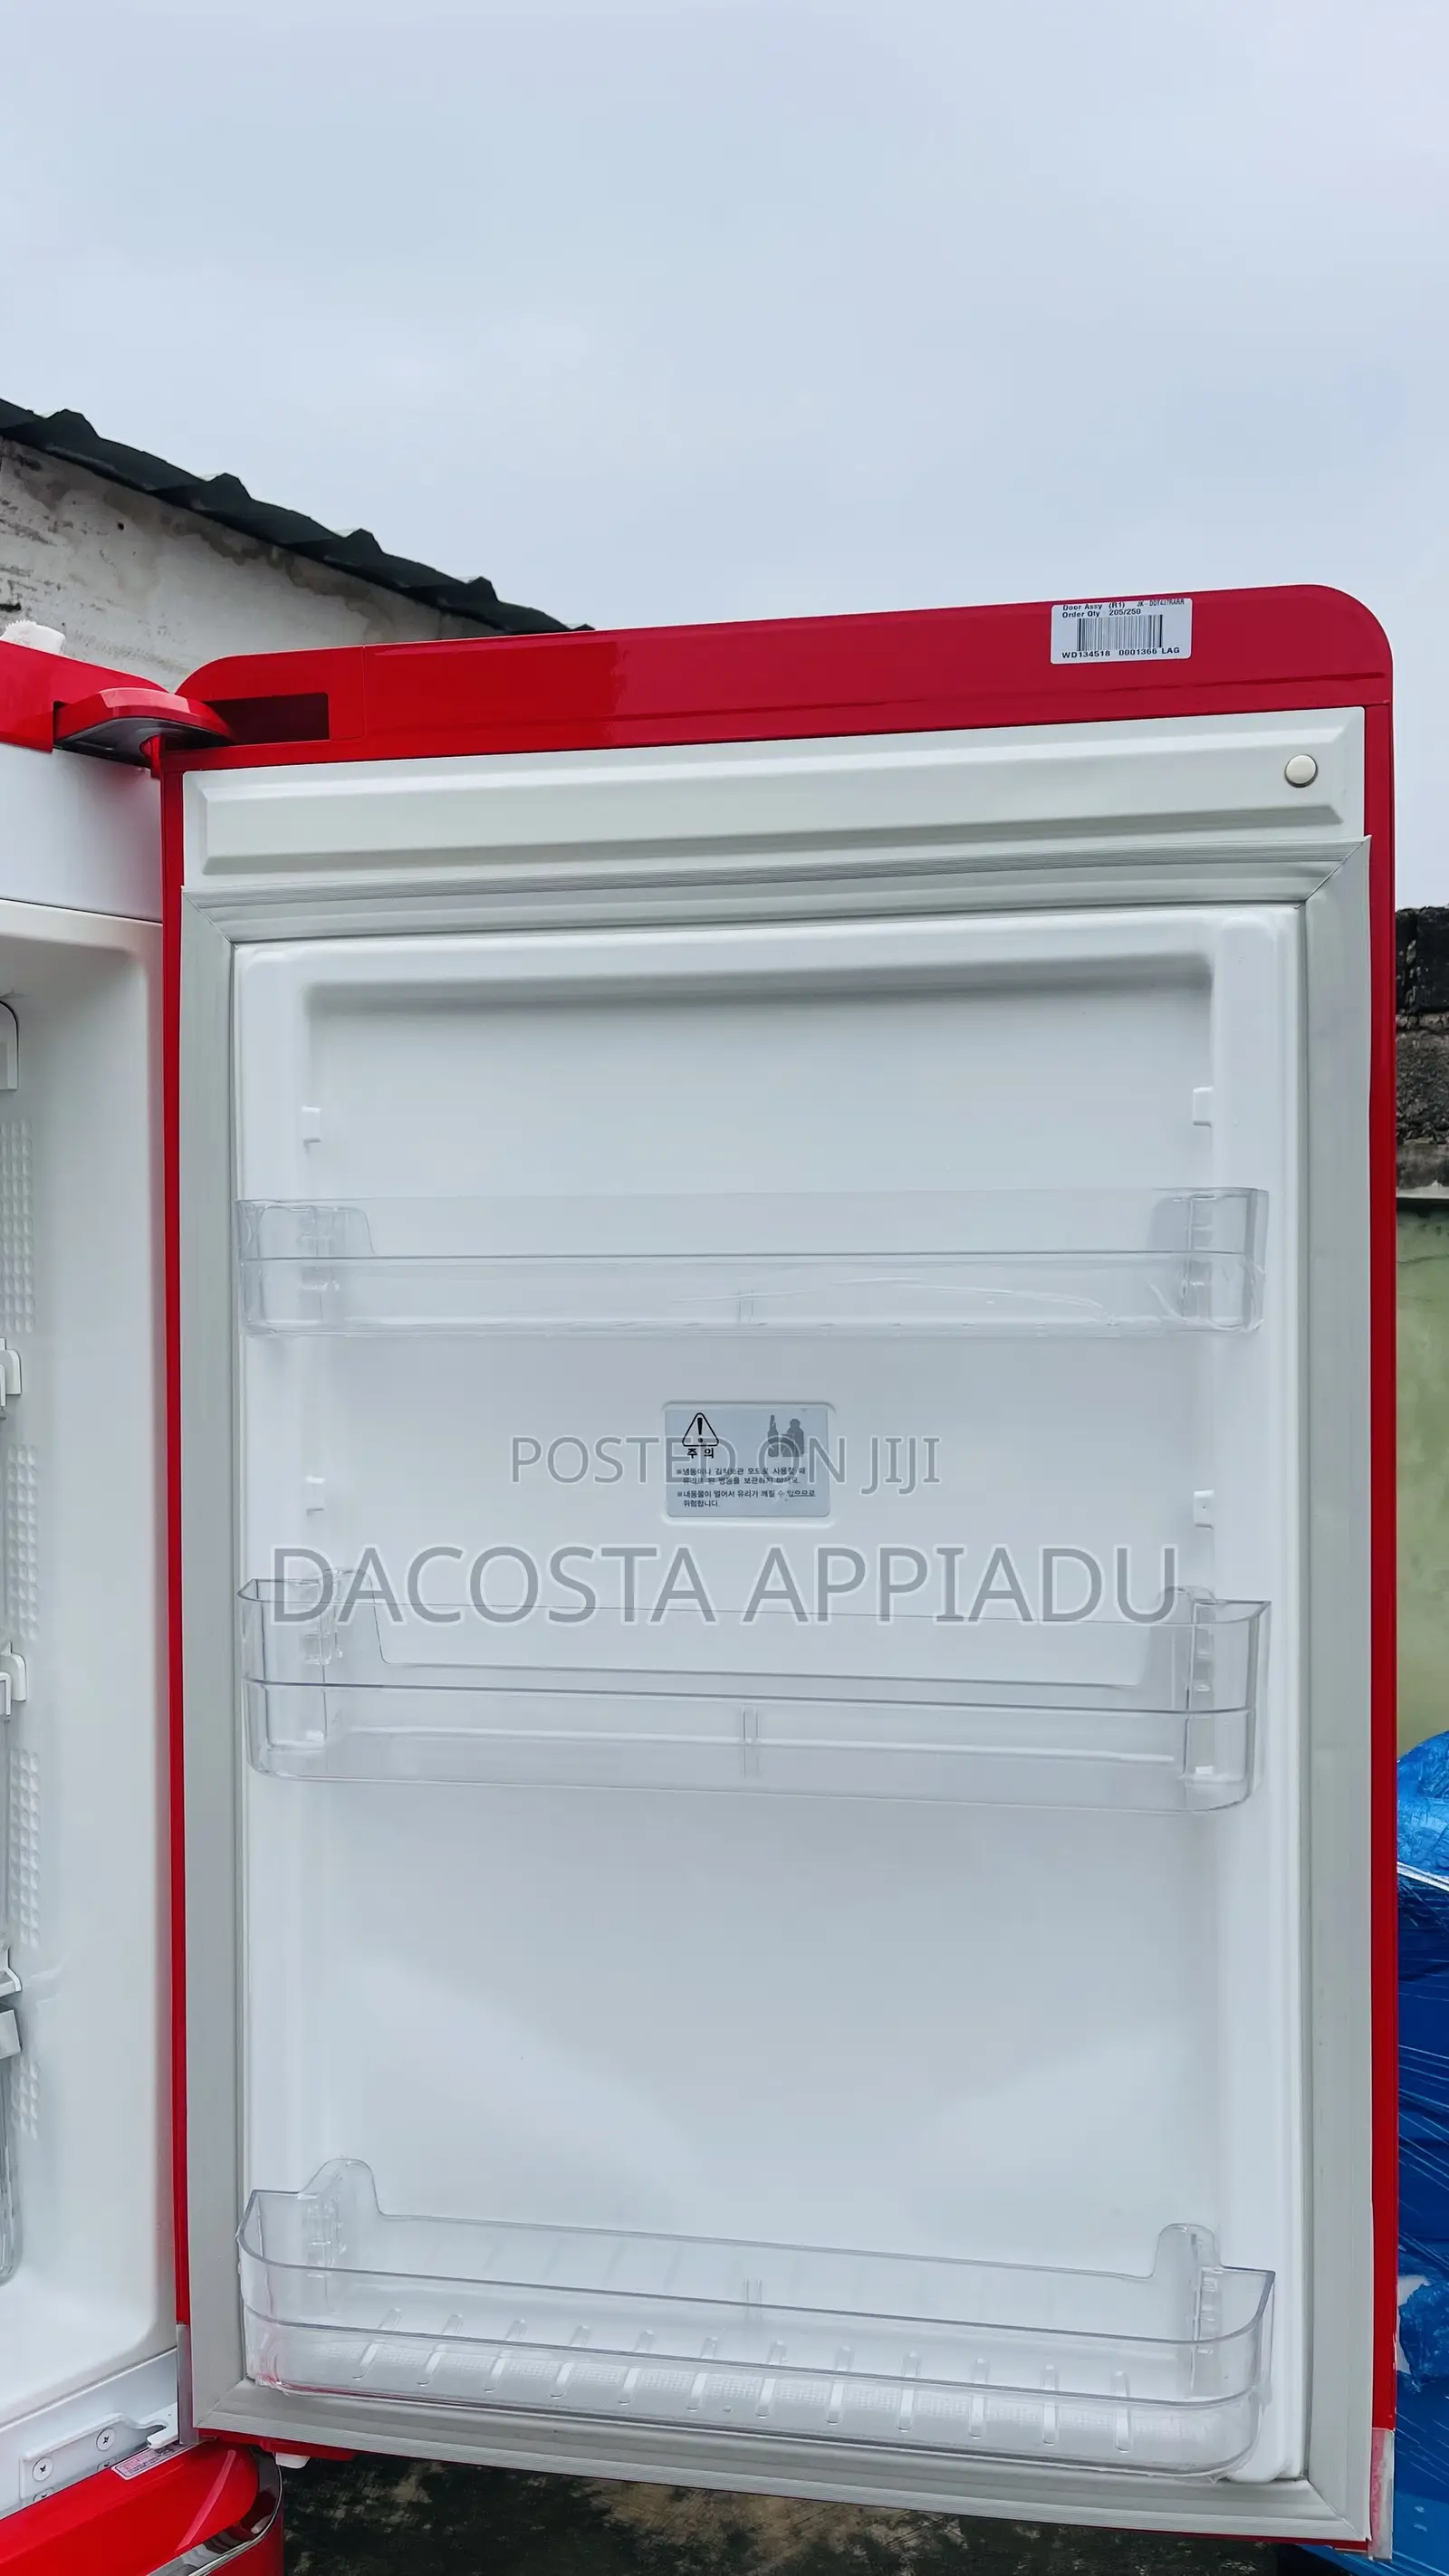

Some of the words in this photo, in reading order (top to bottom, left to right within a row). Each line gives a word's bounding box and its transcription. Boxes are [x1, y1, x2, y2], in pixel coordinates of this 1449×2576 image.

[1108, 601, 1126, 609] (R1)
[1108, 608, 1142, 617] 205/250
[1061, 650, 1111, 658] WD134518
[1118, 647, 1158, 656] 0001366
[1161, 646, 1181, 655] LAG
